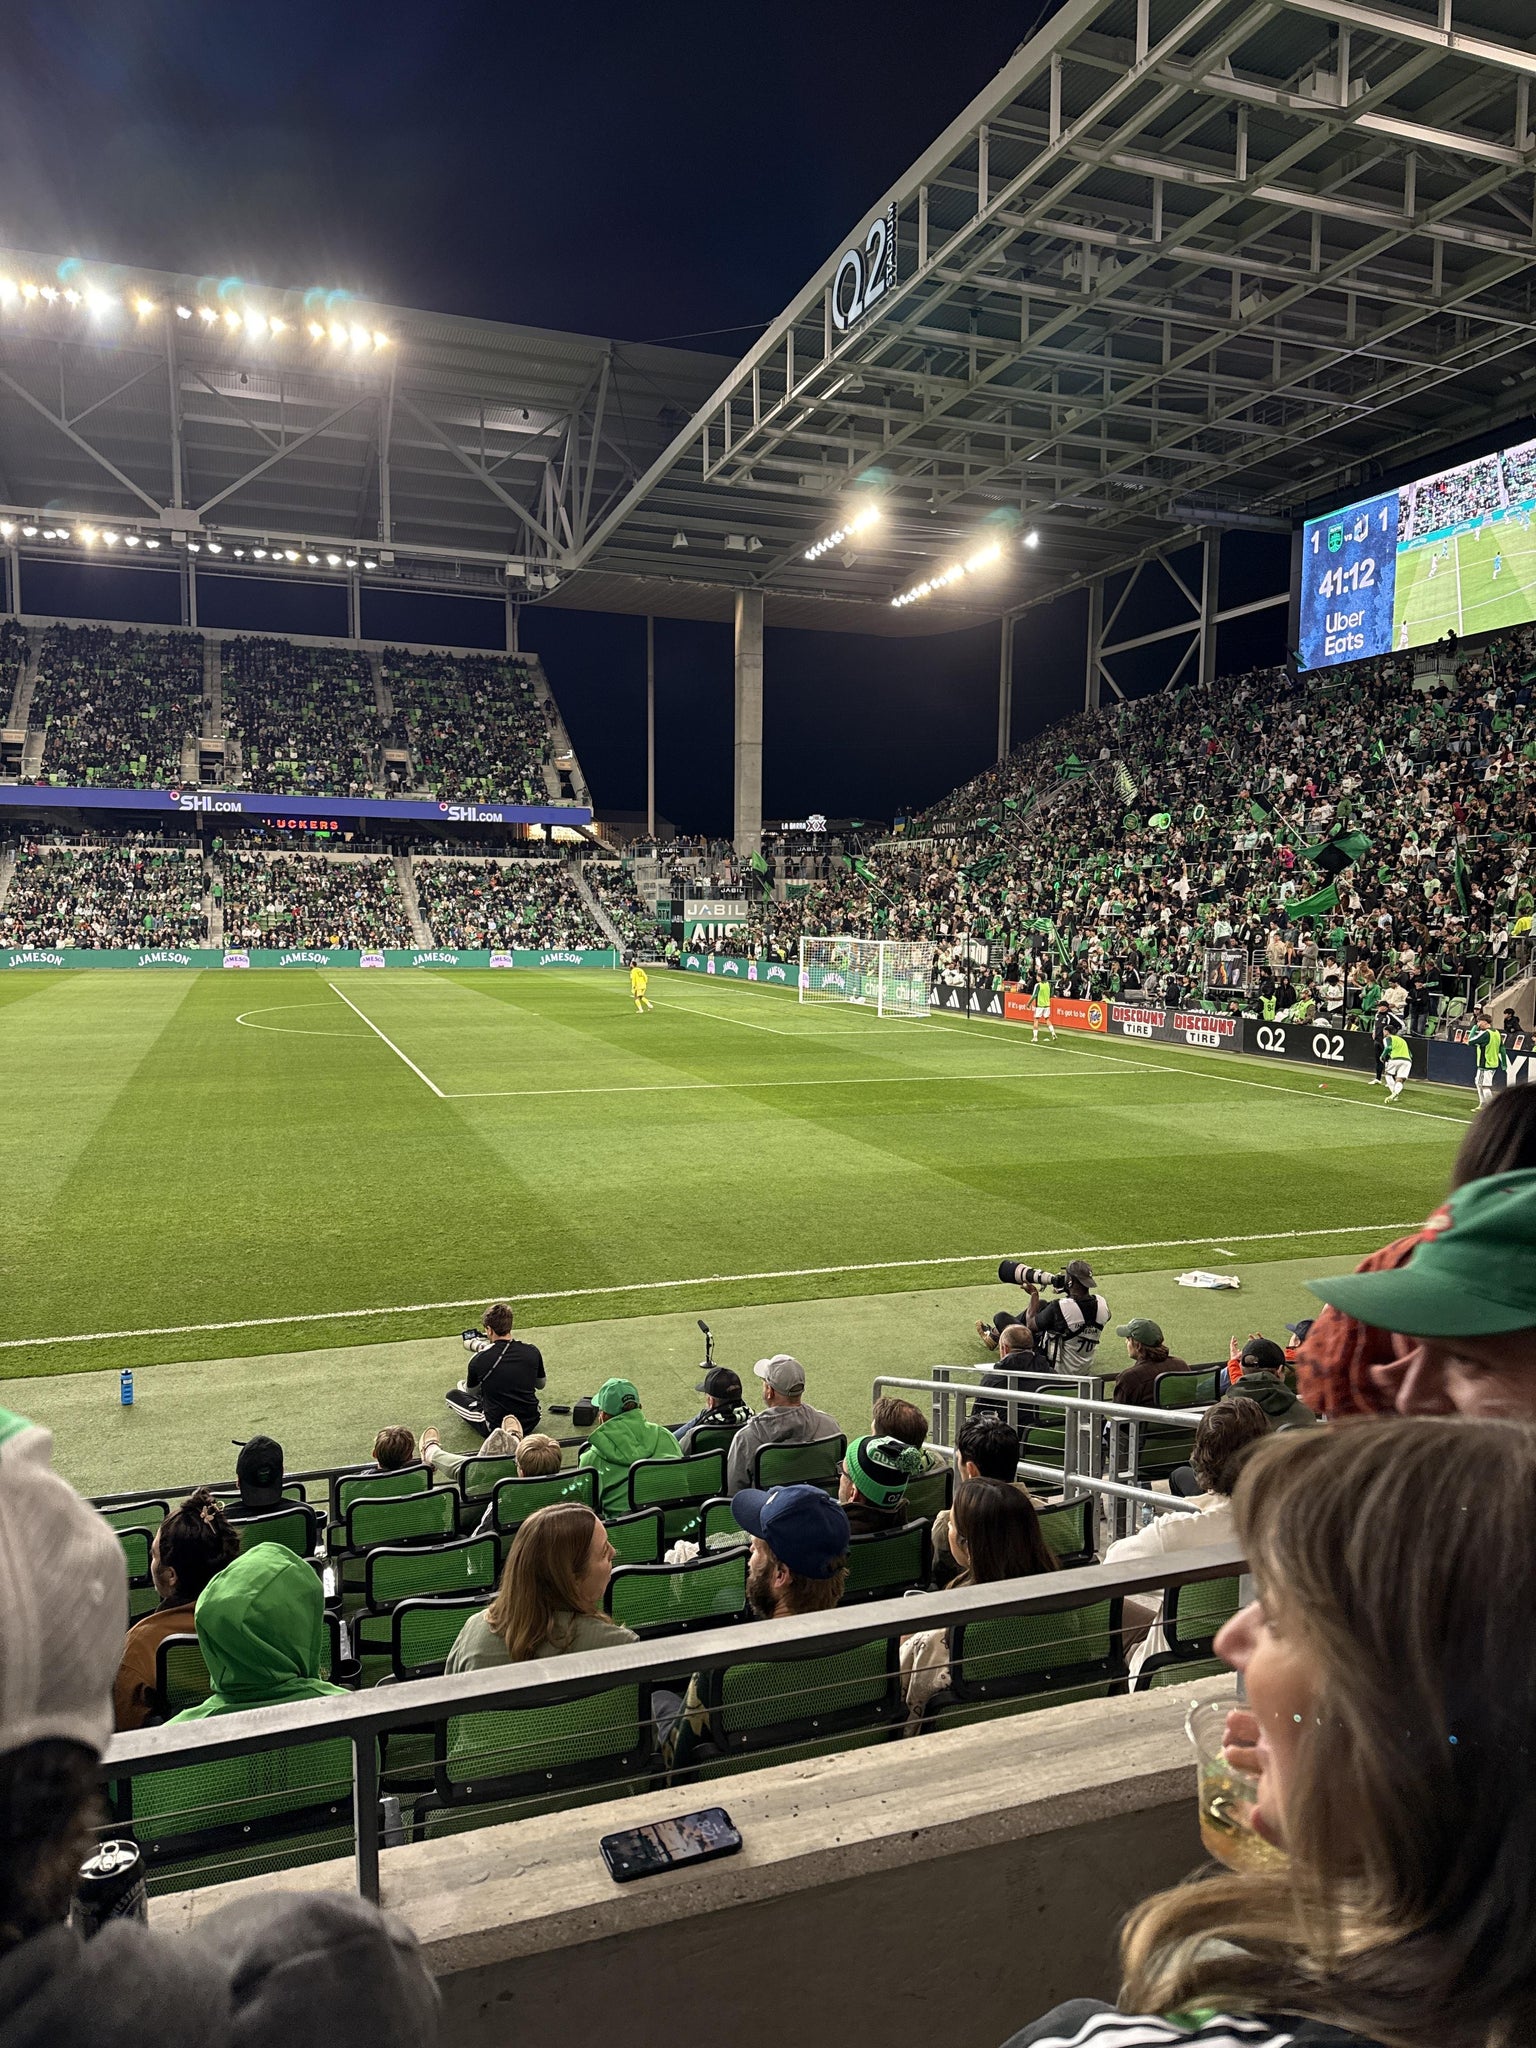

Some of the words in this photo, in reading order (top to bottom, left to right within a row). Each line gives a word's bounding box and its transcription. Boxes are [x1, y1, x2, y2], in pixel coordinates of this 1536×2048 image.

[886, 201, 897, 288] STADIUM
[832, 217, 886, 330] Q2
[1379, 507, 1388, 532] 1
[1310, 530, 1320, 554] 1
[1318, 558, 1376, 599] 41:12
[1325, 609, 1366, 633] Uber
[1324, 633, 1364, 657] Eats
[932, 822, 957, 835] AUSTIN
[687, 903, 746, 916] JABIL
[9, 952, 65, 967] JAMESON
[138, 952, 193, 967] JAMESON
[280, 952, 330, 966] JAMESON
[412, 952, 460, 966] JAMESON
[540, 953, 585, 966] JAMESON
[1064, 1009, 1073, 1017] got
[1112, 1005, 1167, 1028] DISCOUNT
[1173, 1012, 1237, 1037] DISCOUNT
[1127, 1024, 1149, 1034] TIRE
[1190, 1033, 1216, 1044] TIRE
[1256, 1026, 1285, 1053] Q2
[1312, 1033, 1345, 1061] Q2
